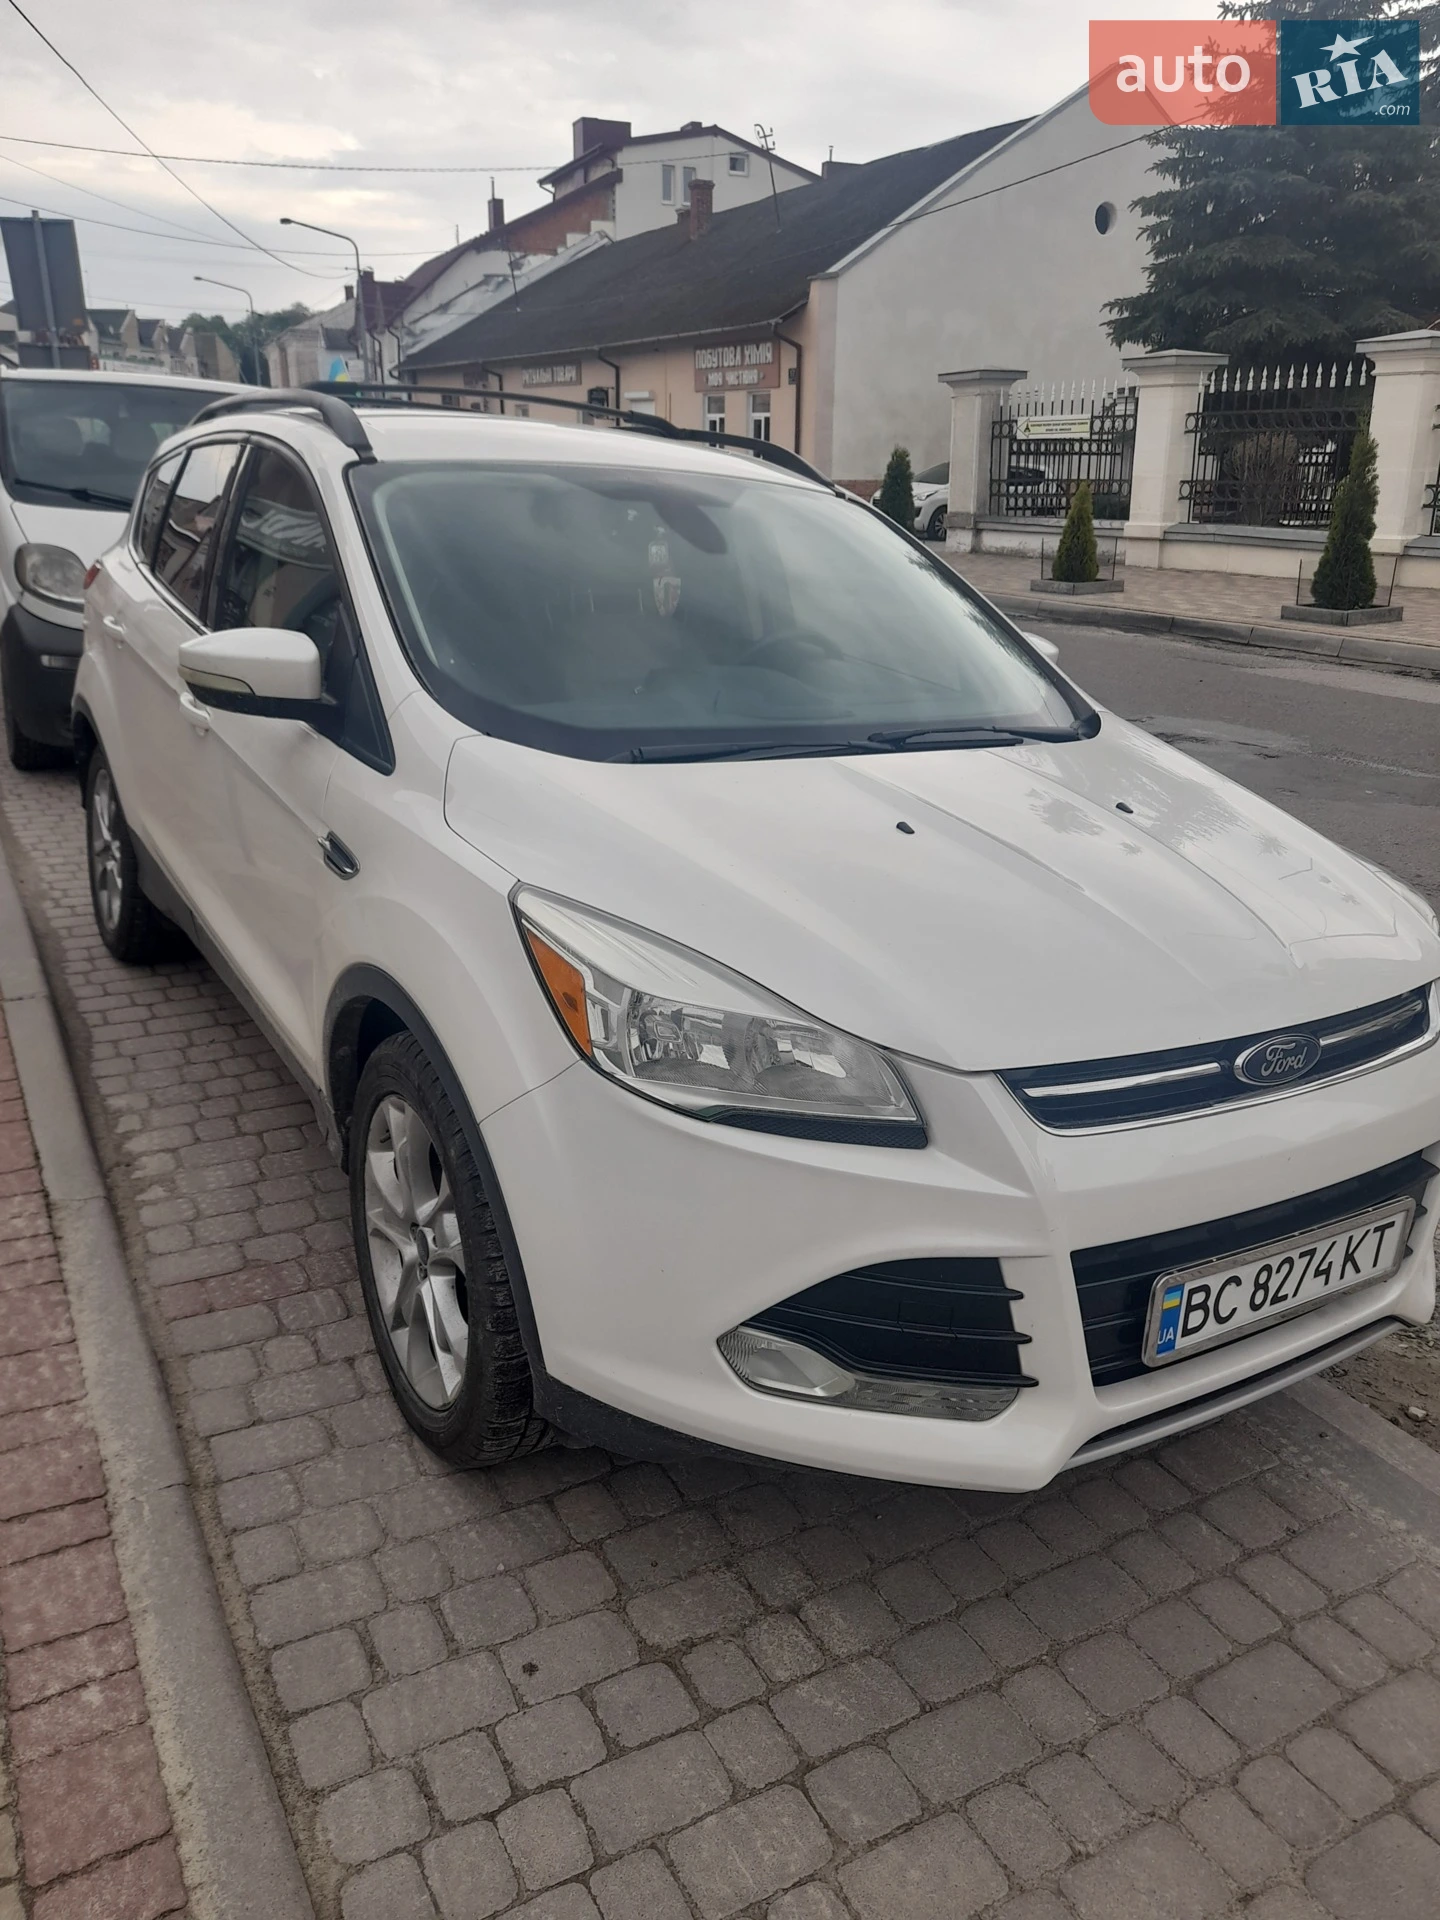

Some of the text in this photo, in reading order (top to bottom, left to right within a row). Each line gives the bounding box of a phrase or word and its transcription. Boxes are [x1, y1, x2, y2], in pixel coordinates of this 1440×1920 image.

[695, 342, 773, 369] ПОБУТОВА ХІМІЯ
[1261, 1042, 1307, 1077] Ford
[1181, 1220, 1395, 1338] BC 8274 KT
[1157, 1326, 1174, 1346] UA
